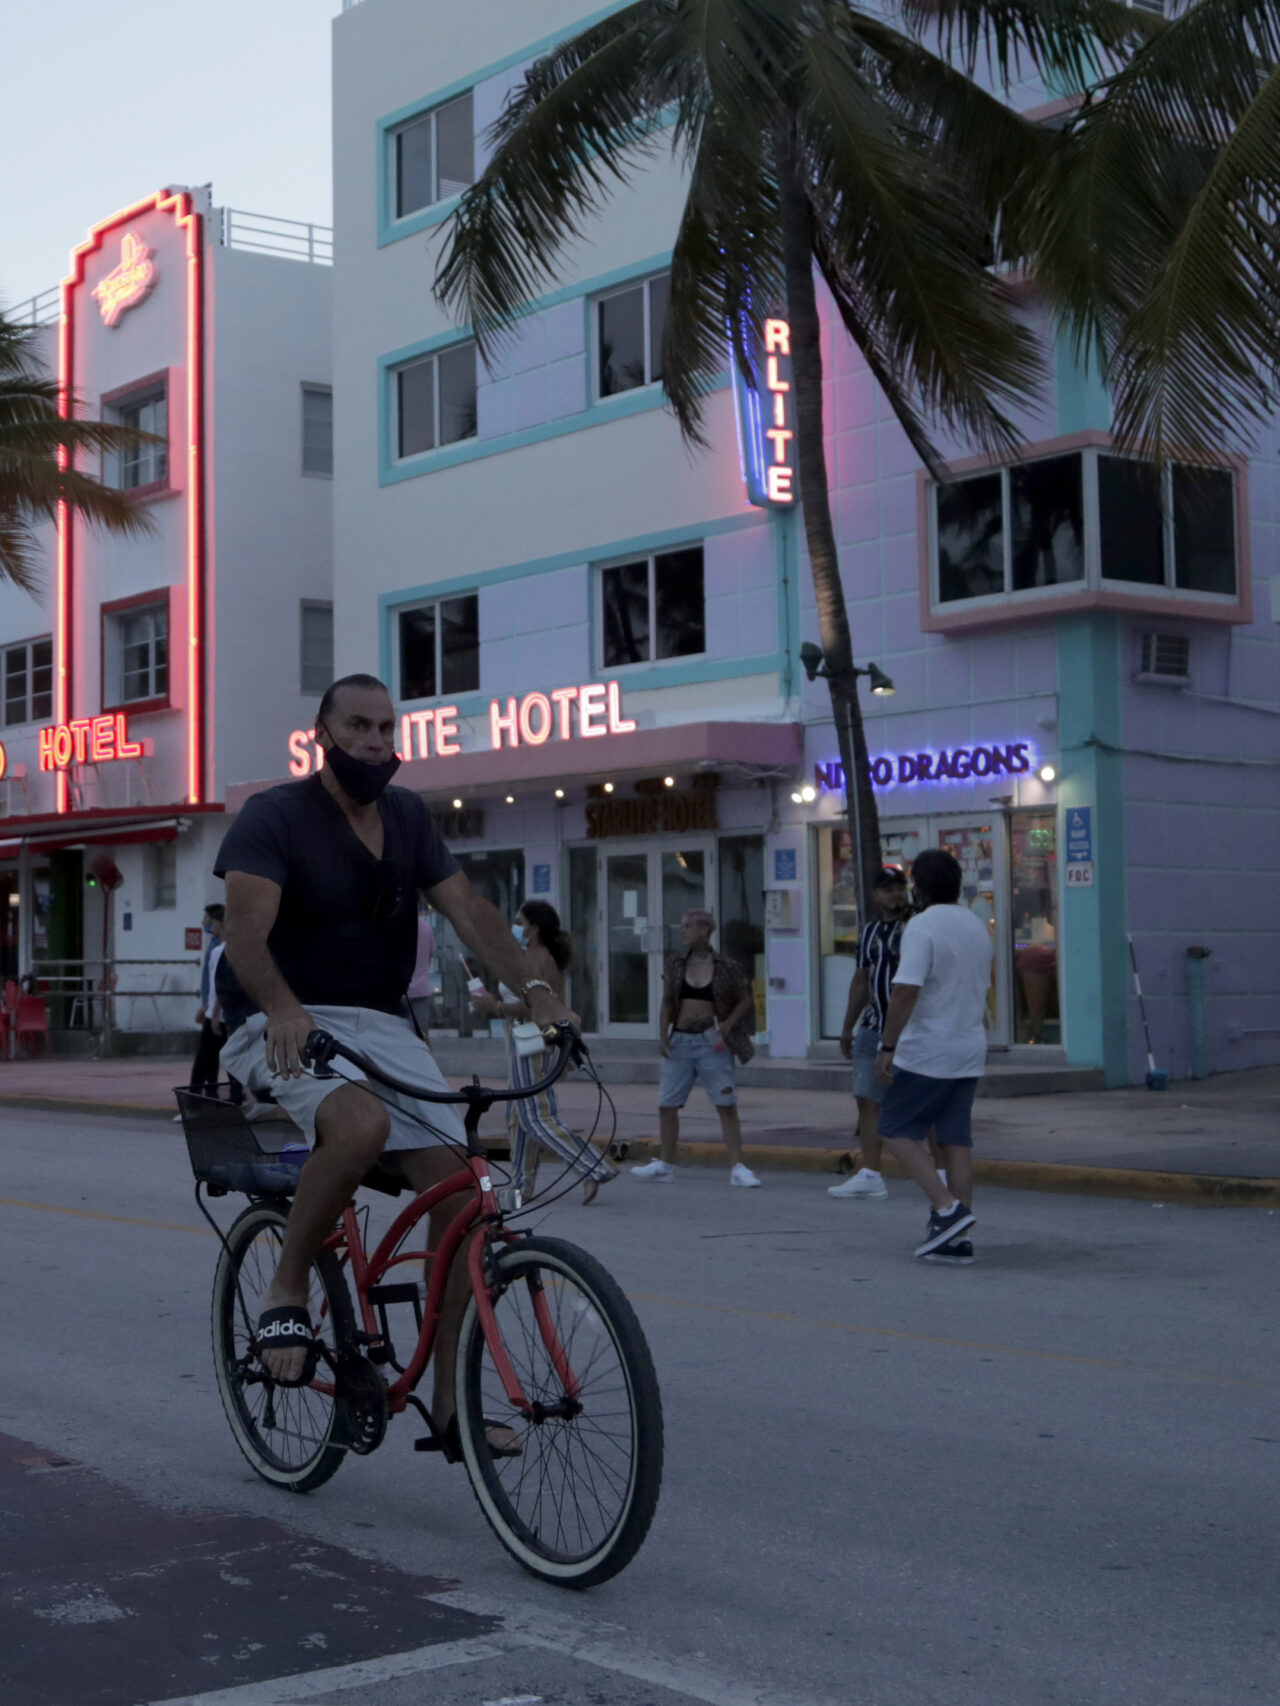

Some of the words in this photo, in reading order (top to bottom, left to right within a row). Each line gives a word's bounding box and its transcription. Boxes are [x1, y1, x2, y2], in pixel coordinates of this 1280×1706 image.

[38, 712, 144, 772] HOTEL
[489, 680, 637, 750] HOTEL
[898, 744, 1030, 784] DRAGONS
